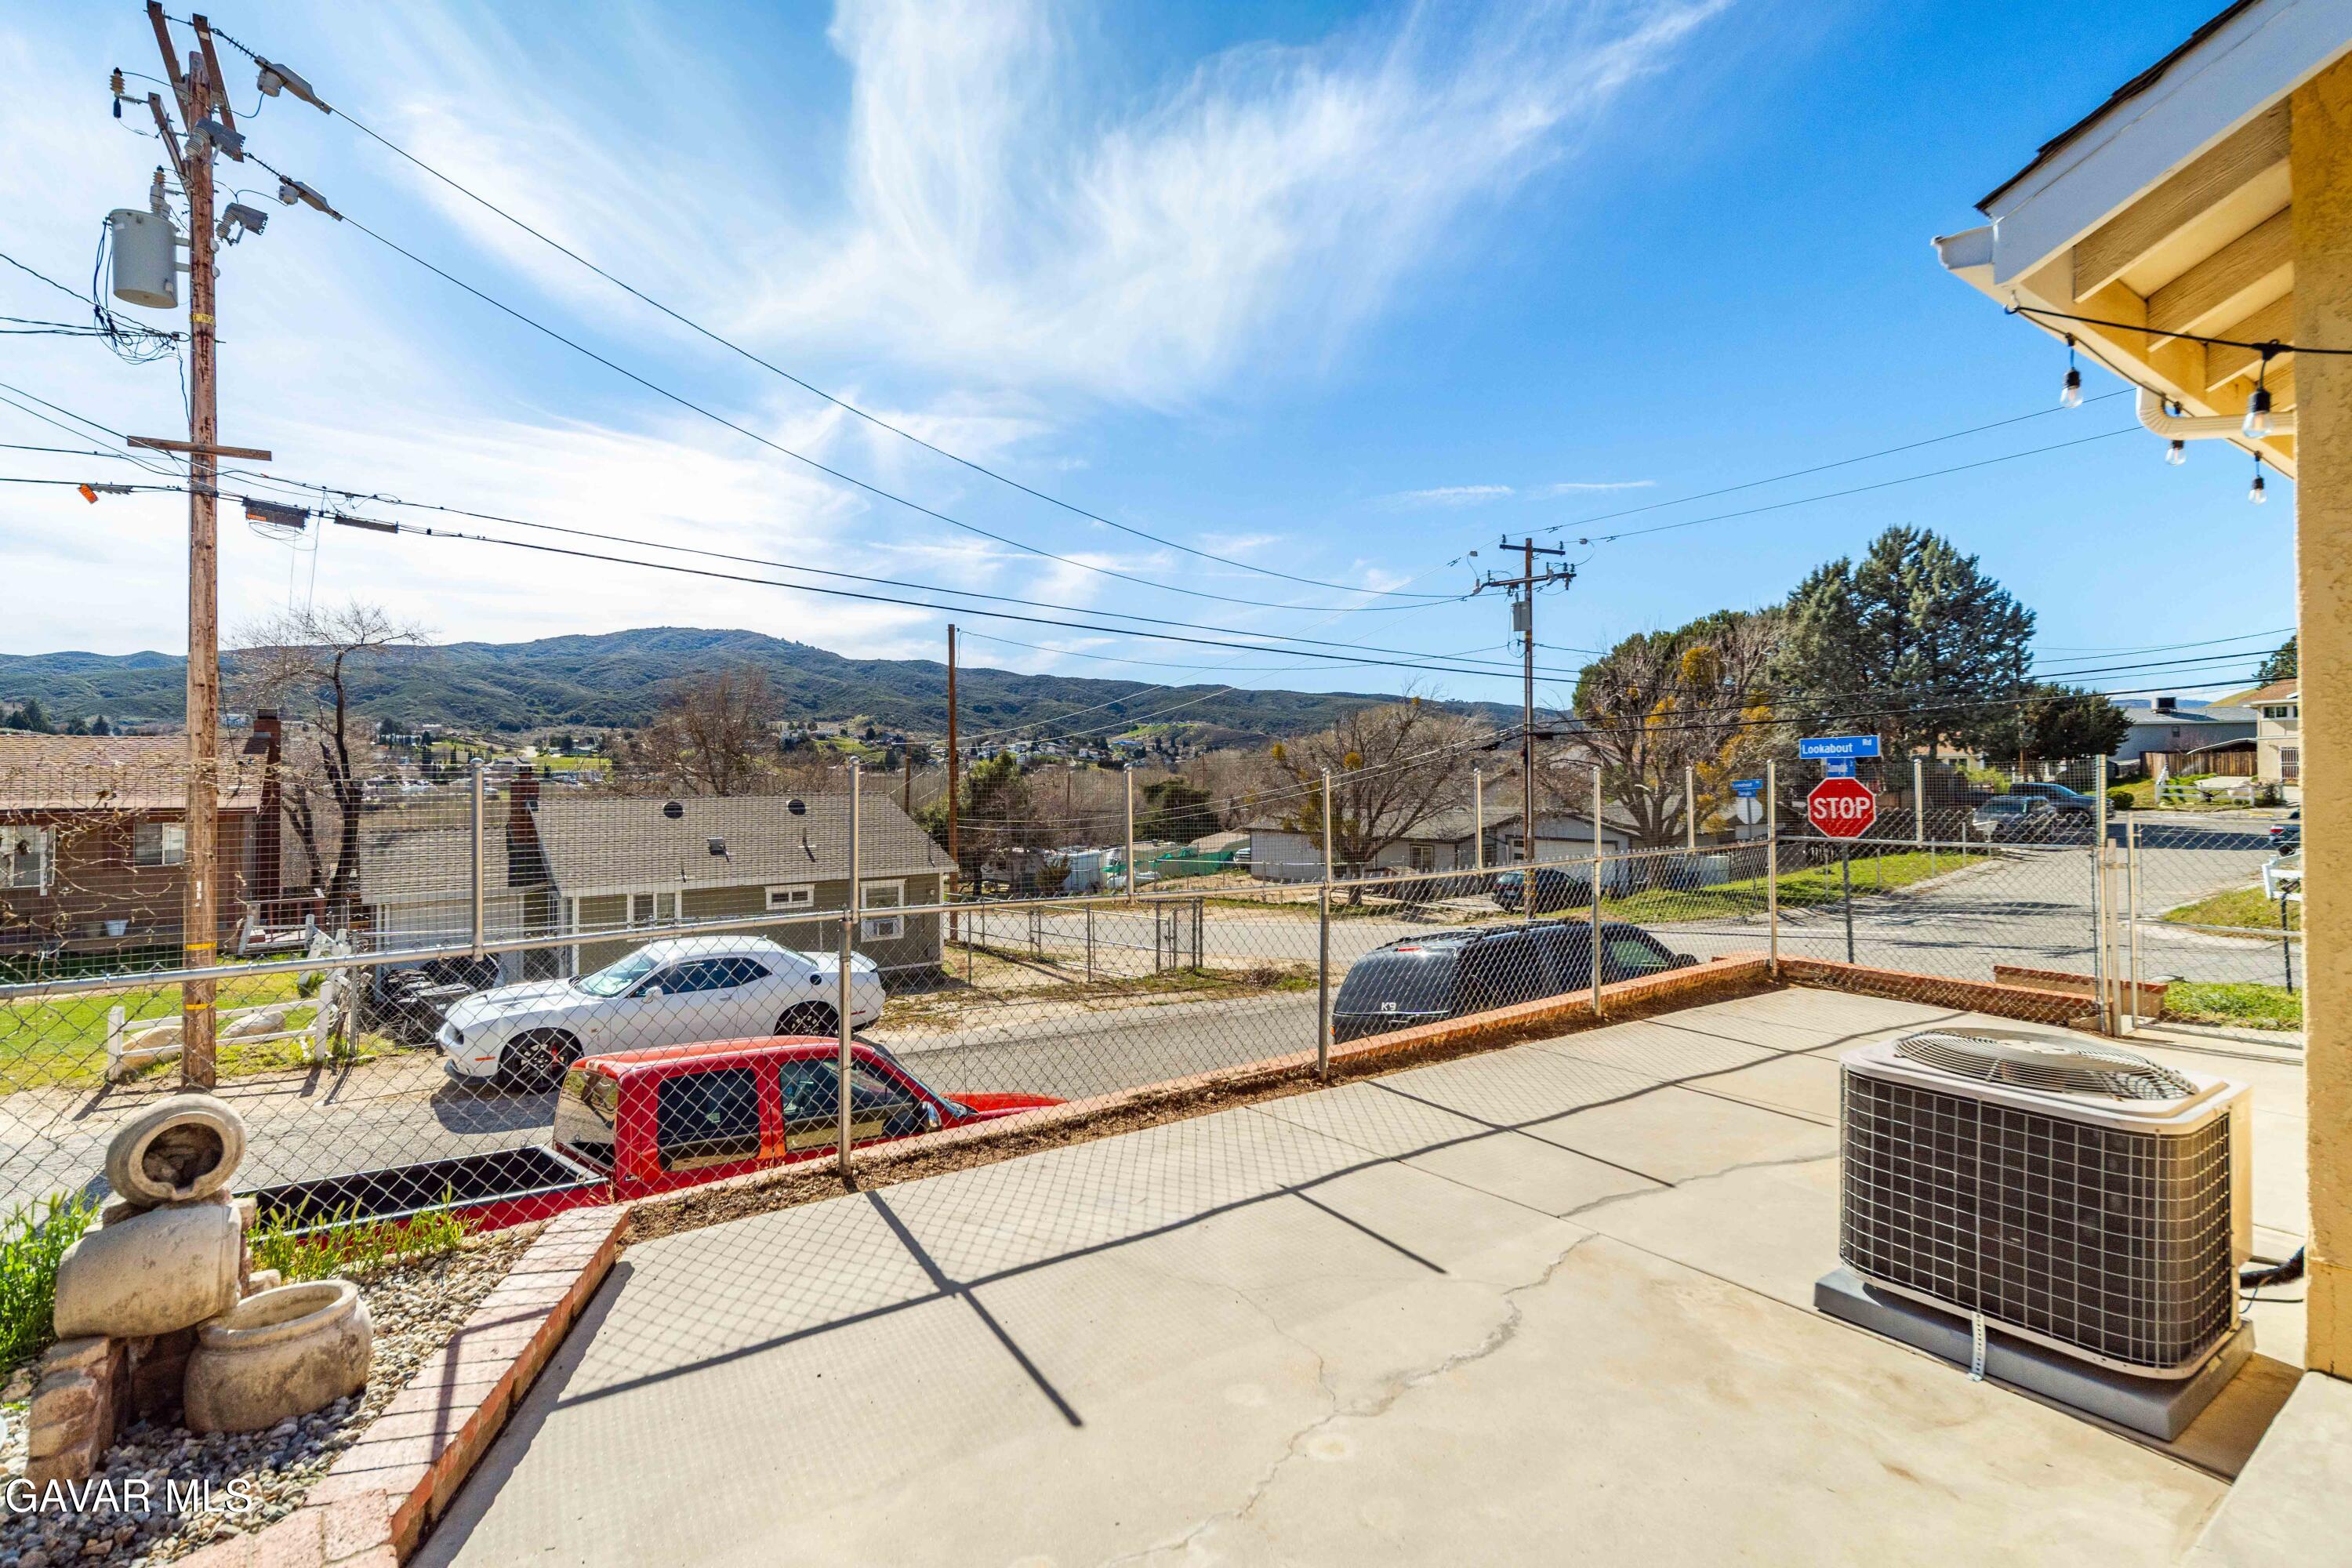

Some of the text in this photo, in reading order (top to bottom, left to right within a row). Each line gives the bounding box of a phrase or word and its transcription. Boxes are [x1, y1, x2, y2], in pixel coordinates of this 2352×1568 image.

[1802, 743, 1853, 754] Lookabout
[1813, 797, 1871, 819] STOP
[1381, 1002, 1396, 1011] K9
